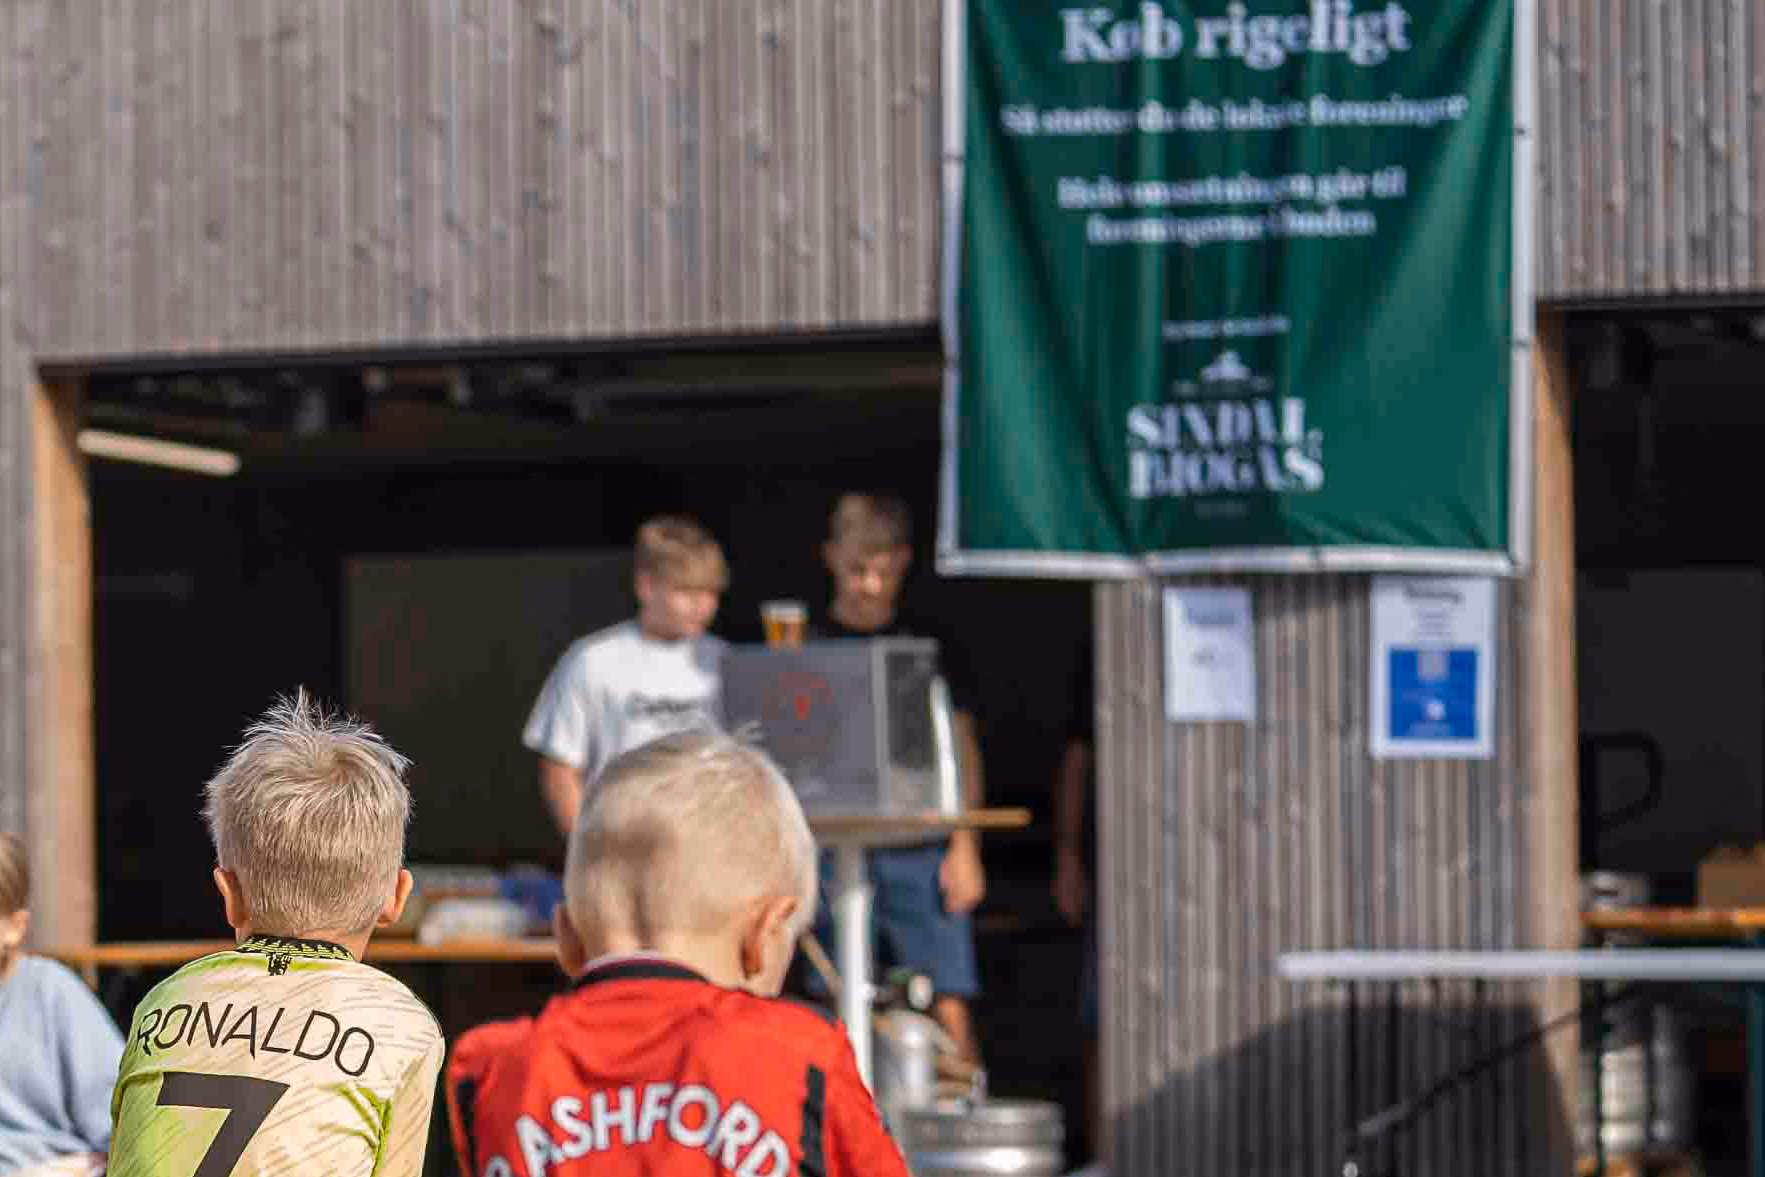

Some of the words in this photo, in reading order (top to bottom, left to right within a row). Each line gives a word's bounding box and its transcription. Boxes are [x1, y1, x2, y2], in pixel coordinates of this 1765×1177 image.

[1060, 1, 1183, 63] Køb
[1194, 0, 1411, 69] rigeligt
[1126, 397, 1314, 451] SINDAL
[134, 1001, 376, 1077] RONALDO
